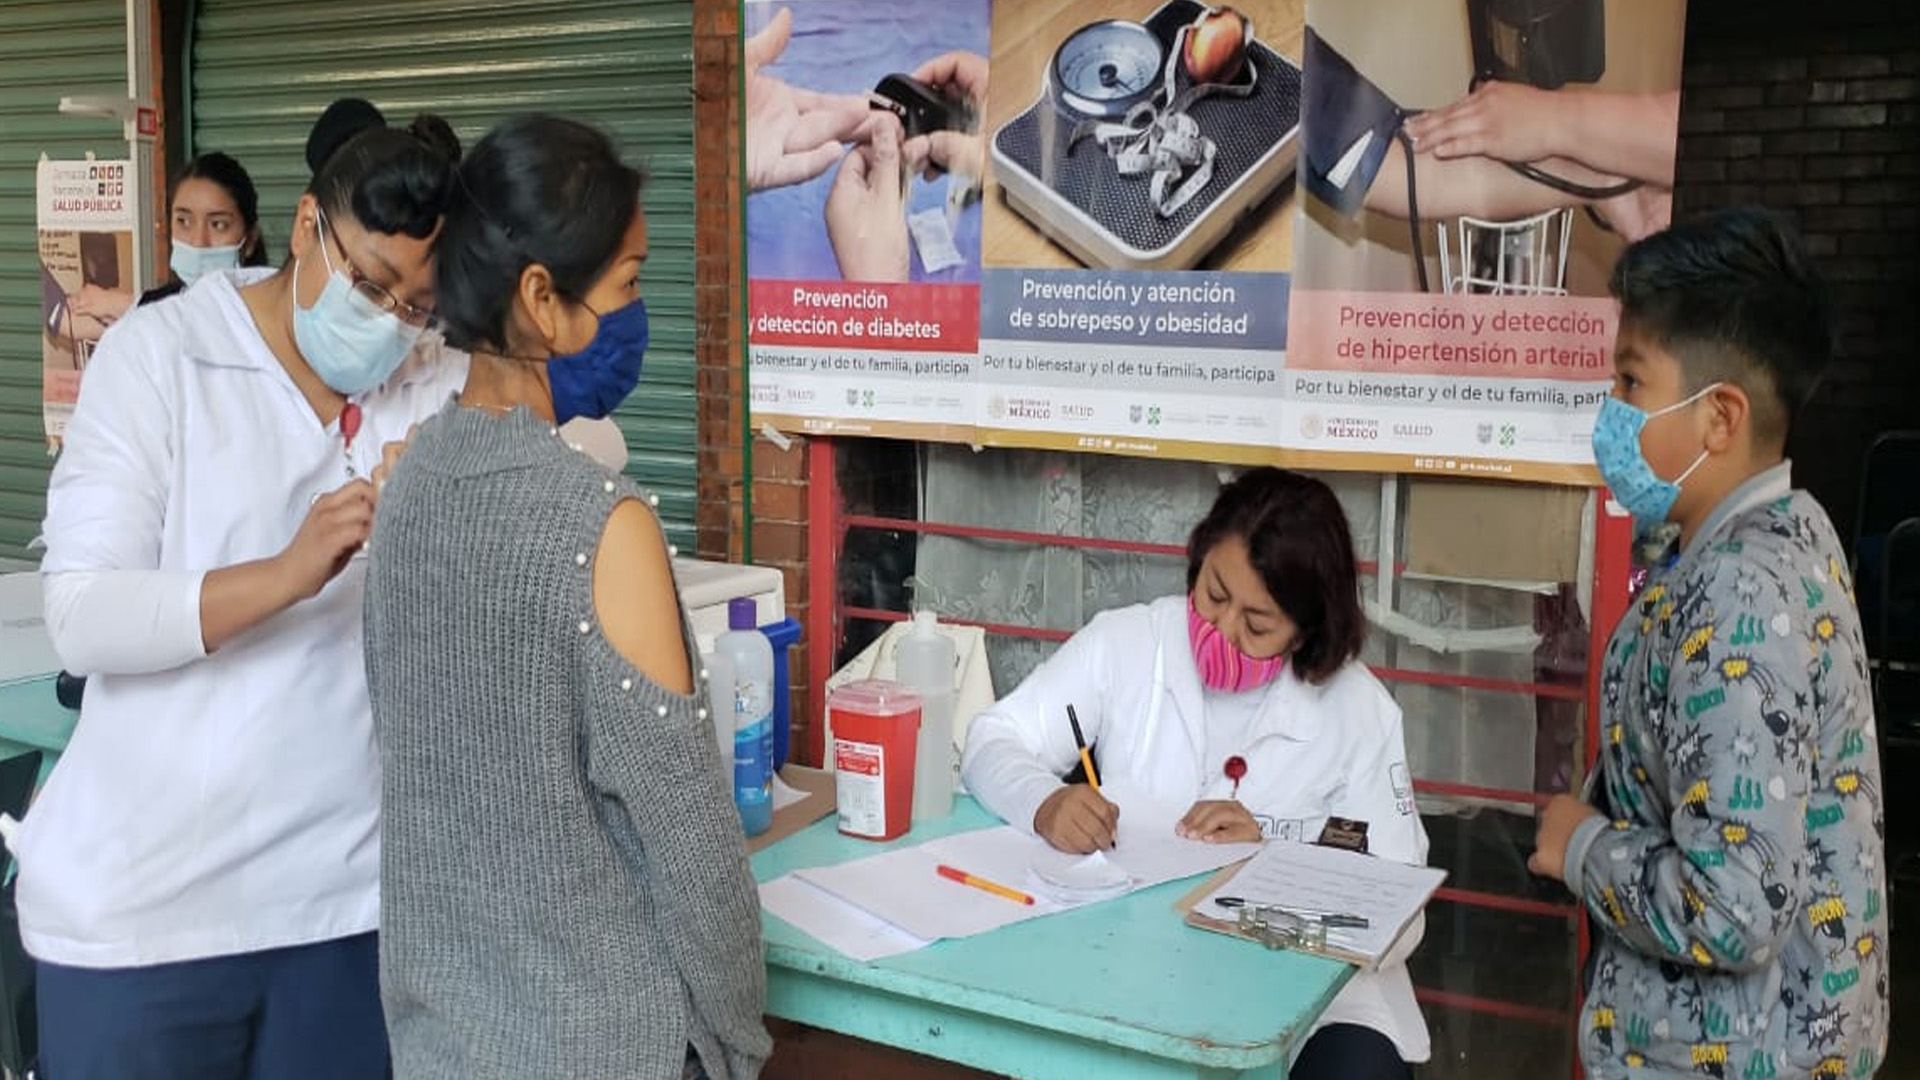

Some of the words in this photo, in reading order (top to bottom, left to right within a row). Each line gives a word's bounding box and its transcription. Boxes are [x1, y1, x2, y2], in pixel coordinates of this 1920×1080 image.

[793, 287, 888, 309] Prevención
[1023, 279, 1126, 301] Prevención
[1130, 286, 1143, 306] y
[1147, 280, 1236, 303] atención
[757, 312, 838, 335] detección
[842, 315, 864, 336] de
[867, 316, 941, 338] diabetes
[1009, 307, 1033, 327] de
[1037, 307, 1134, 334] sobrepeso
[1138, 314, 1150, 336] y
[1155, 311, 1248, 335] obesidad
[1340, 306, 1465, 331] Prevención
[1471, 314, 1485, 336] y
[1491, 310, 1605, 335] detección
[755, 353, 807, 368] bienestar
[810, 357, 818, 371] y
[821, 356, 832, 369] el
[834, 356, 851, 369] de
[853, 358, 866, 370] tu
[868, 358, 912, 374] familia,
[915, 359, 970, 376] participa
[1336, 337, 1366, 358] de
[1371, 338, 1517, 365] hipertensión
[1524, 344, 1605, 368] arterial
[984, 355, 1005, 368] Por
[1009, 357, 1022, 370] tu
[1026, 356, 1086, 374] bienestar
[1090, 362, 1099, 376] y
[1102, 360, 1113, 375] el
[1117, 361, 1134, 375] de
[1138, 363, 1152, 376] tu
[1156, 362, 1207, 380] familia,
[1211, 366, 1275, 383] participa
[1295, 378, 1323, 394] Por
[1326, 380, 1343, 395] tu
[1348, 379, 1424, 399] bienestar
[1428, 386, 1438, 402] y
[1442, 384, 1456, 399] el
[1461, 385, 1482, 400] de
[1487, 387, 1504, 401] tu
[1509, 386, 1569, 407] familia,
[1008, 405, 1051, 420] MÉXICO
[1061, 405, 1095, 418] SALUD
[1326, 425, 1379, 440] MÉXICO
[1392, 423, 1434, 437] SALUD
[1808, 1010, 1839, 1039] POW!
